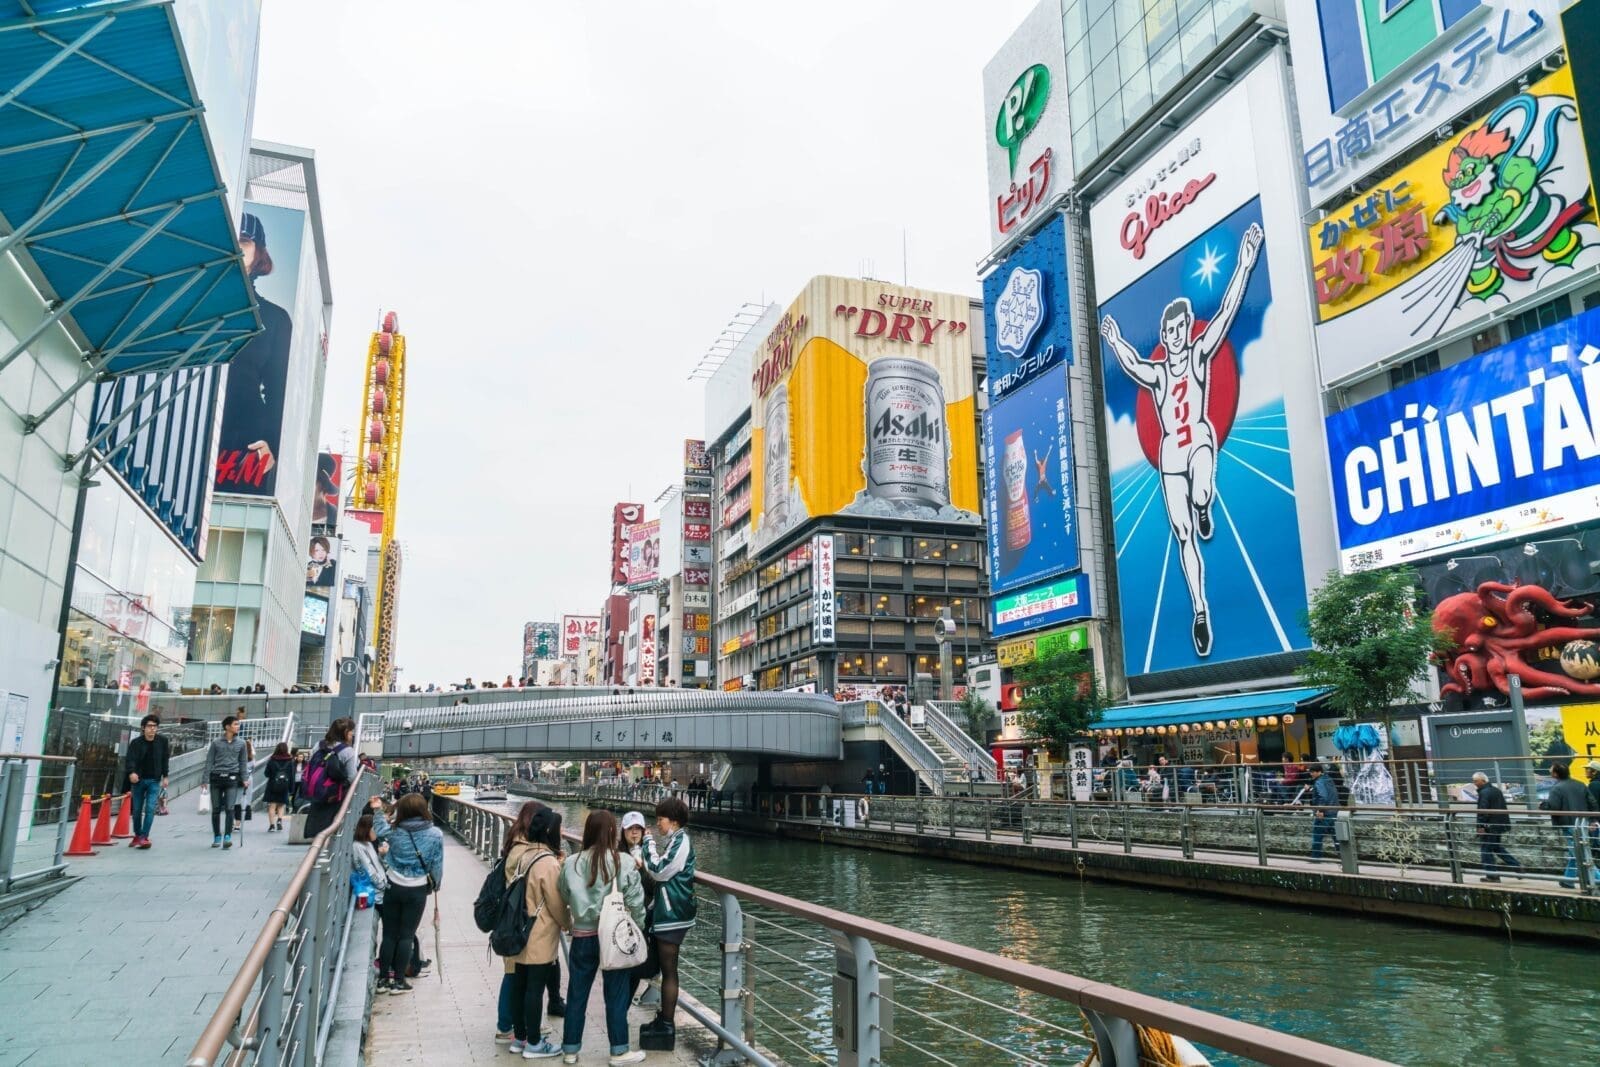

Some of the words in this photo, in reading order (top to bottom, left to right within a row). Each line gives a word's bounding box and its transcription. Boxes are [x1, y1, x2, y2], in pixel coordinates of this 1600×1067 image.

[1304, 9, 1544, 187] 日商エステム
[997, 148, 1052, 233] ピップ
[1120, 172, 1217, 260] Glico
[1318, 180, 1411, 251] かぜに
[1313, 201, 1432, 304] 改源
[877, 293, 933, 313] SUPER
[992, 343, 1054, 395] 雪印メグミルク
[872, 407, 940, 444] Asahi
[1171, 374, 1193, 449] グリコ
[216, 450, 271, 488] H&M
[888, 463, 929, 475] スーパードライ
[898, 448, 918, 463] 生
[899, 485, 918, 494] 350ml
[1349, 548, 1384, 567] 天気予報
[1014, 586, 1055, 609] 大阪ニュース
[567, 619, 598, 635] かに
[594, 730, 673, 743] えびす橋
[1462, 726, 1503, 736] information
